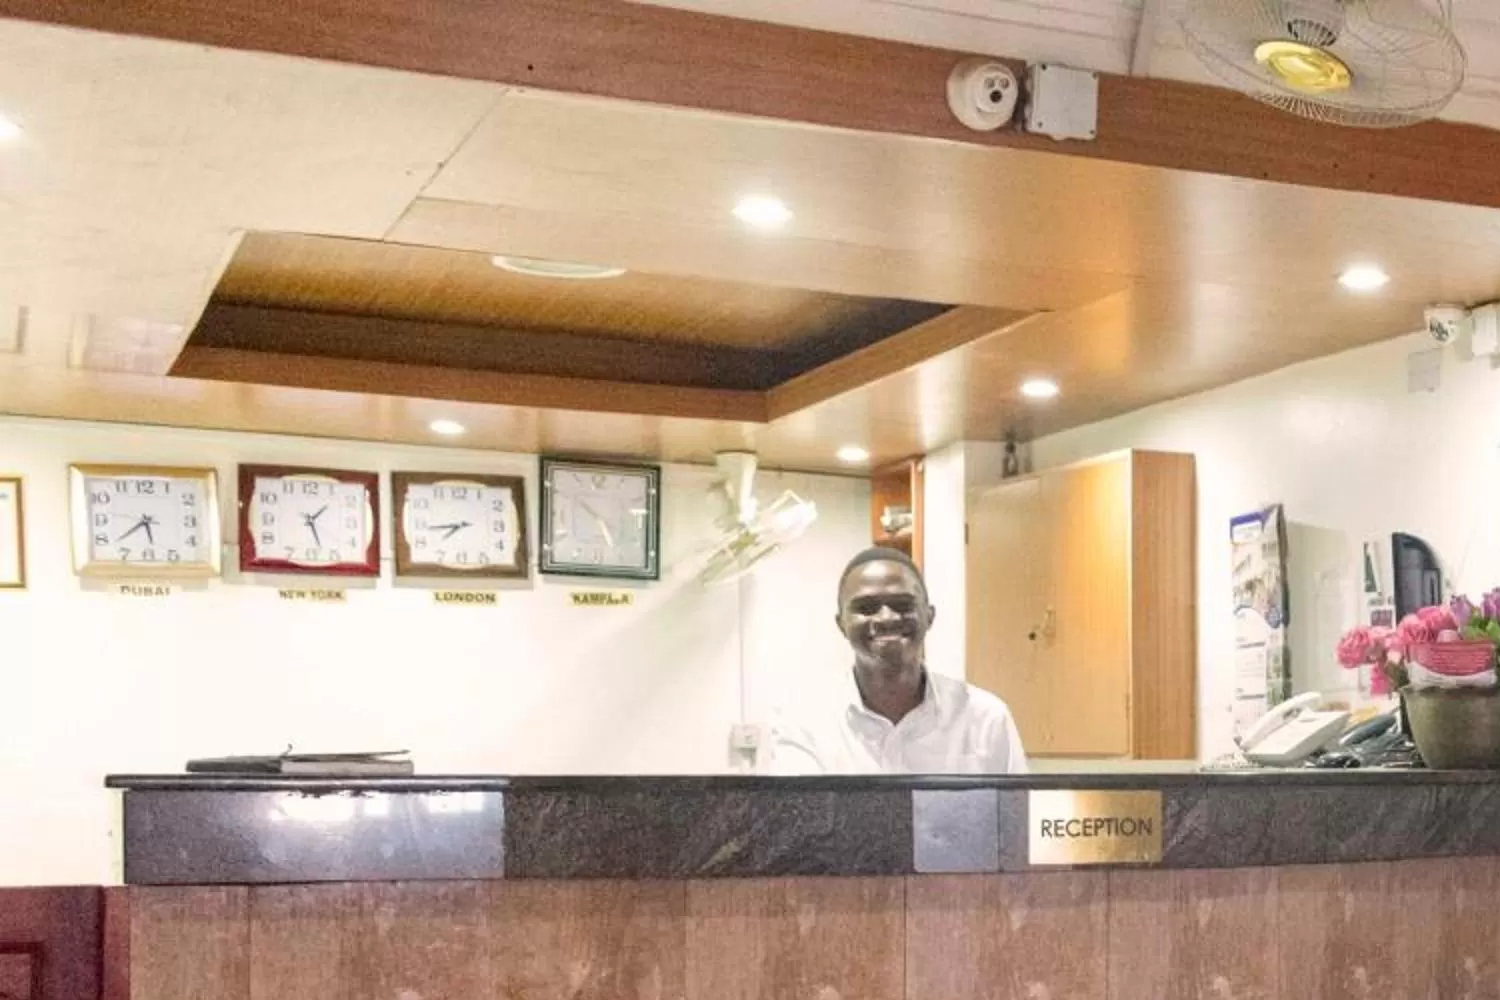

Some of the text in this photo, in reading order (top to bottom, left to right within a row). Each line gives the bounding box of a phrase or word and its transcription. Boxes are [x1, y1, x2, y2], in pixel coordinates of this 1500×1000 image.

[120, 584, 171, 597] DUBAI
[279, 589, 342, 601] NEW YORK
[434, 591, 497, 603] LONDON
[1041, 817, 1153, 838] RECEPTION
